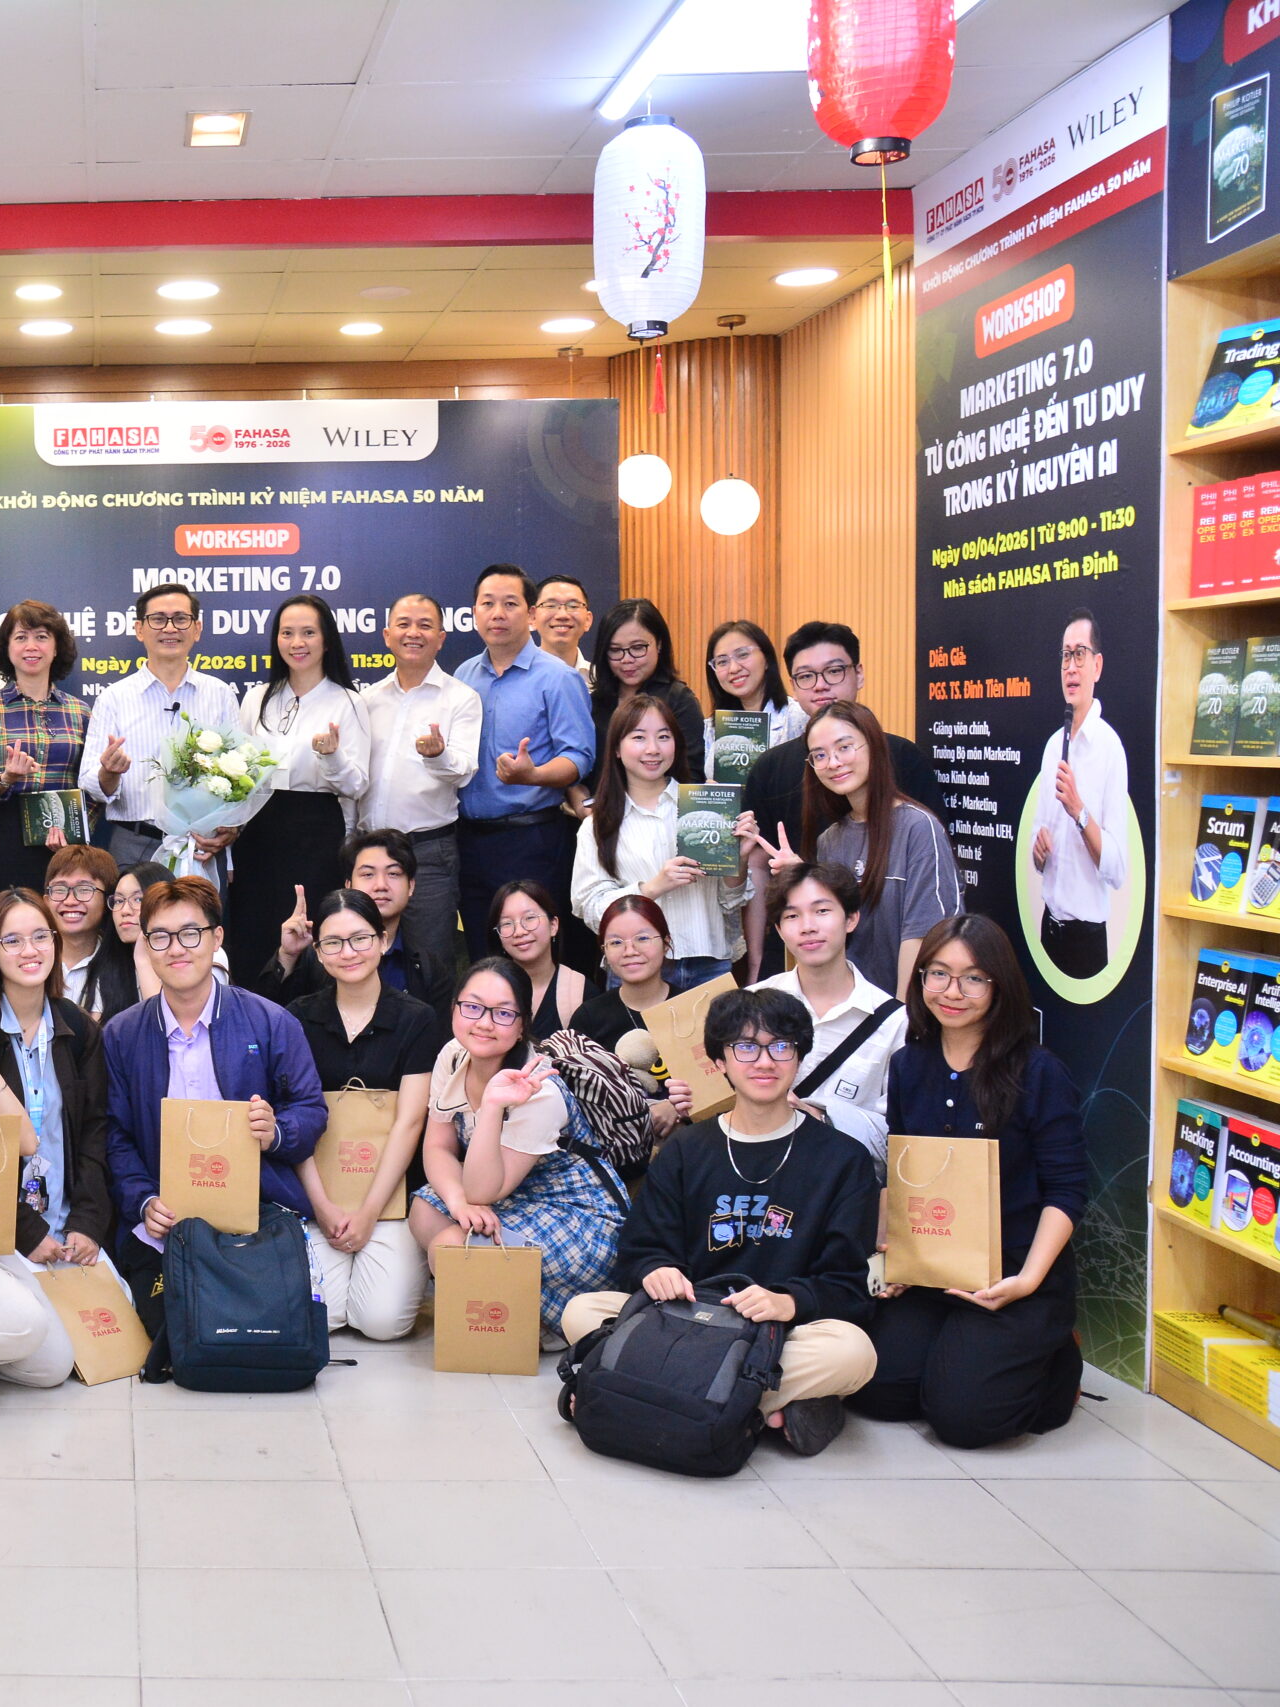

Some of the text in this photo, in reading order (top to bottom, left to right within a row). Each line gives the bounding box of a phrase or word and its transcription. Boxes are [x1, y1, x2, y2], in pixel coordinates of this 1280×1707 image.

[1067, 86, 1144, 150] WILEY
[1019, 137, 1056, 170] FAHASA
[1039, 153, 1056, 173] 2026
[992, 157, 1019, 203] 50
[926, 177, 984, 234] FAHASA
[999, 229, 1025, 253] TRÌNH
[1040, 206, 1064, 232] NIỆM
[1064, 183, 1106, 216] FAHASA
[1107, 174, 1119, 196] 50
[1121, 157, 1151, 188] NĂM
[982, 278, 1066, 345] WORKSHOP
[1224, 341, 1280, 363] Trading
[960, 338, 1093, 419] MARKETING 7.0
[234, 428, 290, 439] FAHASA
[925, 373, 1146, 476] TỪ CÔNG NGHỆ ĐẾN TƯ DUY
[54, 427, 160, 447] FAHASA
[189, 425, 233, 452] 50
[234, 440, 258, 448] 1976
[268, 439, 290, 448] 2026
[323, 426, 418, 448] WILEY
[943, 439, 1118, 517] TRONG KỶ NGUYÊN AI
[42, 491, 97, 511] ĐỘNG
[102, 490, 183, 507] CHƯƠNG
[188, 487, 246, 507] TRÌNH
[250, 486, 275, 505] KỶ
[280, 486, 327, 508] NIỆM
[331, 489, 408, 504] FAHASA
[413, 489, 436, 504] 50
[440, 484, 484, 503] NĂM
[185, 529, 290, 550] WORKSHOP
[931, 544, 960, 569] Ngày
[962, 529, 1028, 561] 09/04/2026
[1038, 522, 1055, 543] Từ
[1057, 516, 1088, 541] 9:00
[1100, 505, 1135, 533] 11:30
[132, 565, 342, 593] MARKETING 7.0
[943, 550, 1118, 599] Nhà sách FAHASA Tân Định
[212, 609, 271, 635] DUY
[82, 655, 131, 674] Ngày
[351, 653, 396, 669] 11:30
[1006, 677, 1031, 697] Minh
[933, 721, 990, 738] Giảng viên chính,
[716, 744, 767, 753] MARKETING
[731, 752, 750, 766] 7.0
[933, 745, 1021, 765] Trưởng Bộ môn Marketing
[951, 770, 966, 784] Kinh
[968, 771, 990, 786] doanh
[962, 796, 998, 815] Marketing
[700, 829, 720, 845] 7.0
[956, 820, 972, 835] Kinh
[972, 822, 995, 837] doanh
[995, 824, 1014, 841] UEH,
[1206, 816, 1245, 837] Scrum
[958, 844, 982, 861] Kinh tế
[1197, 972, 1247, 995] Enterprise AI
[1180, 1125, 1215, 1156] Hacking
[338, 1141, 378, 1166] 50
[1228, 1145, 1280, 1179] Accounting
[189, 1154, 230, 1180] 50
[192, 1180, 227, 1188] FAHASA
[715, 1194, 769, 1217] SEZ
[908, 1197, 956, 1227] 50
[911, 1226, 952, 1237] FAHASA
[78, 1308, 117, 1331] 50
[465, 1301, 509, 1325] 50
[92, 1327, 121, 1338] FAHASA
[469, 1325, 505, 1333] FAHASA
